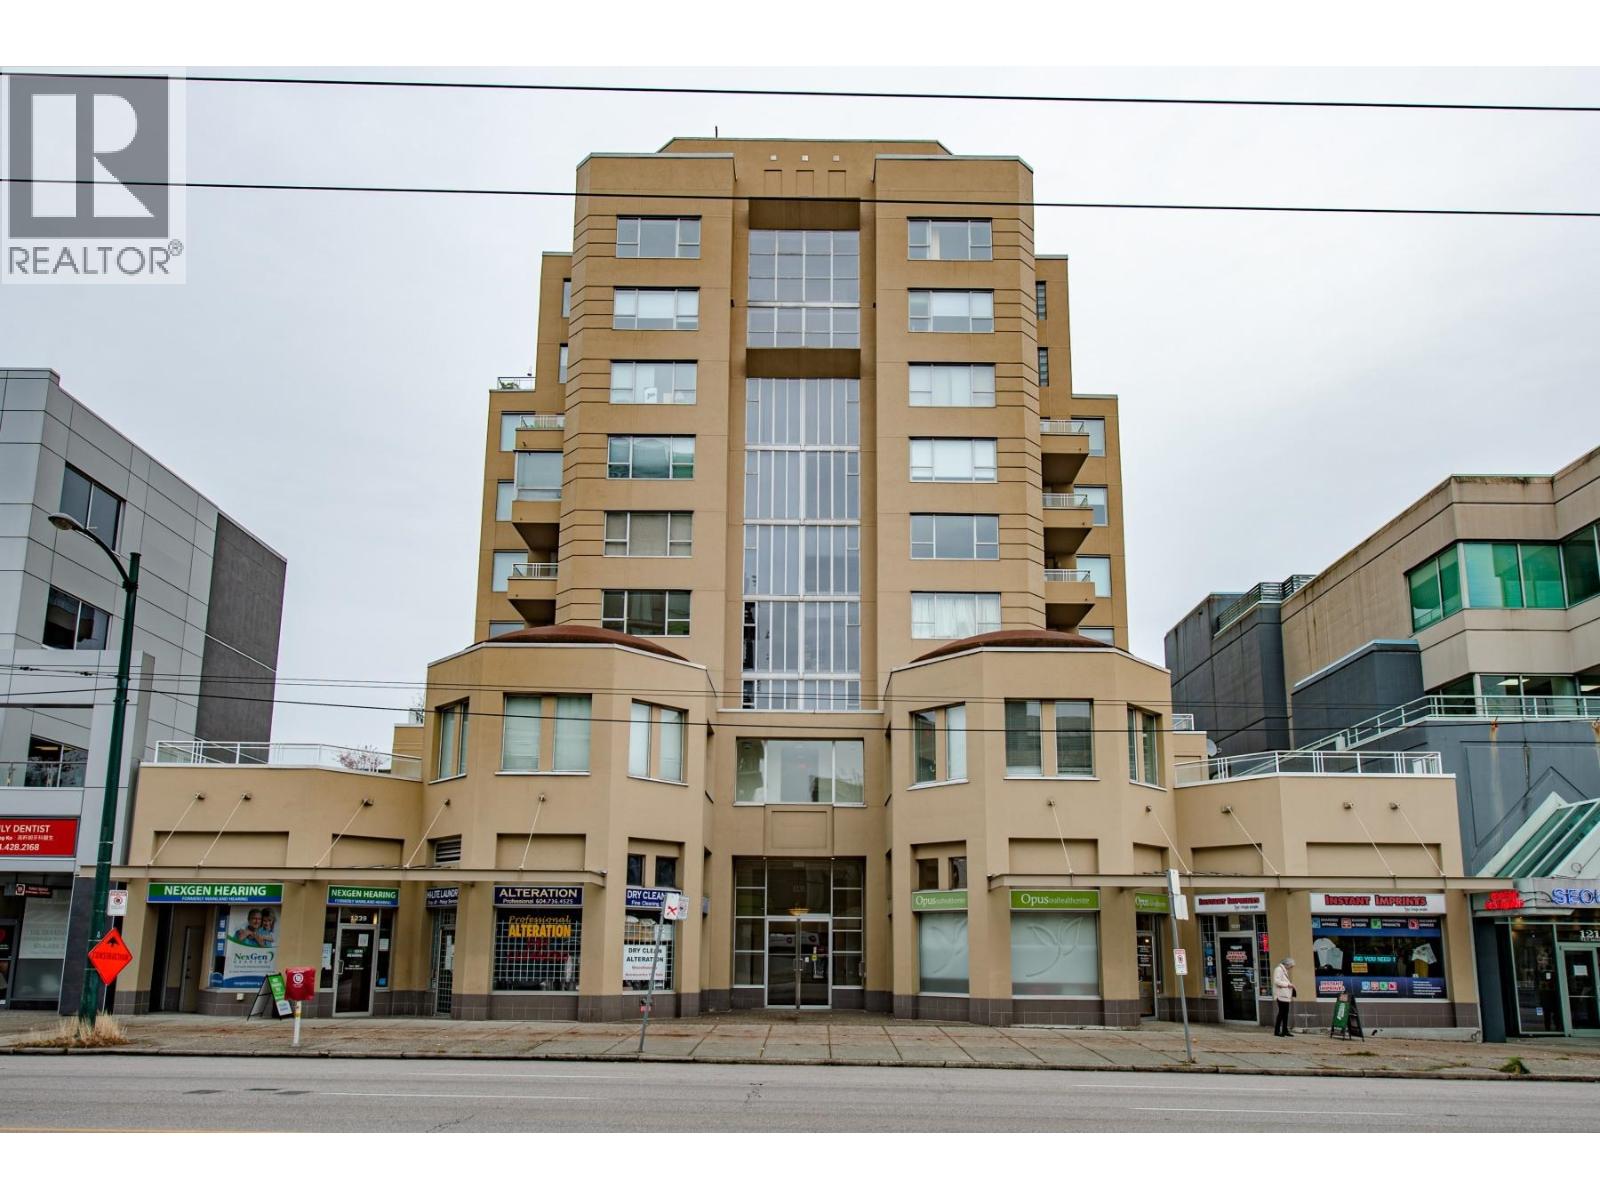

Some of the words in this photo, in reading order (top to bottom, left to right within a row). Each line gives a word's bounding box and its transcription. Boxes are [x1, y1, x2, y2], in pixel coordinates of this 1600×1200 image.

[13, 824, 51, 833] DENTIST
[164, 885, 211, 896] NEXGEN
[214, 886, 267, 896] HEARING
[331, 889, 362, 897] NEXGEN
[363, 890, 397, 899] HEARING
[499, 888, 578, 898] ALTERATION
[627, 890, 642, 899] DRY
[915, 895, 937, 908] Opus
[1021, 893, 1049, 907] Opus
[1325, 894, 1371, 906] INSTANT
[1374, 895, 1428, 907] IMPRINTS
[508, 915, 571, 925] Professional
[508, 924, 572, 938] ALTERATION
[234, 952, 268, 961] NexGen
